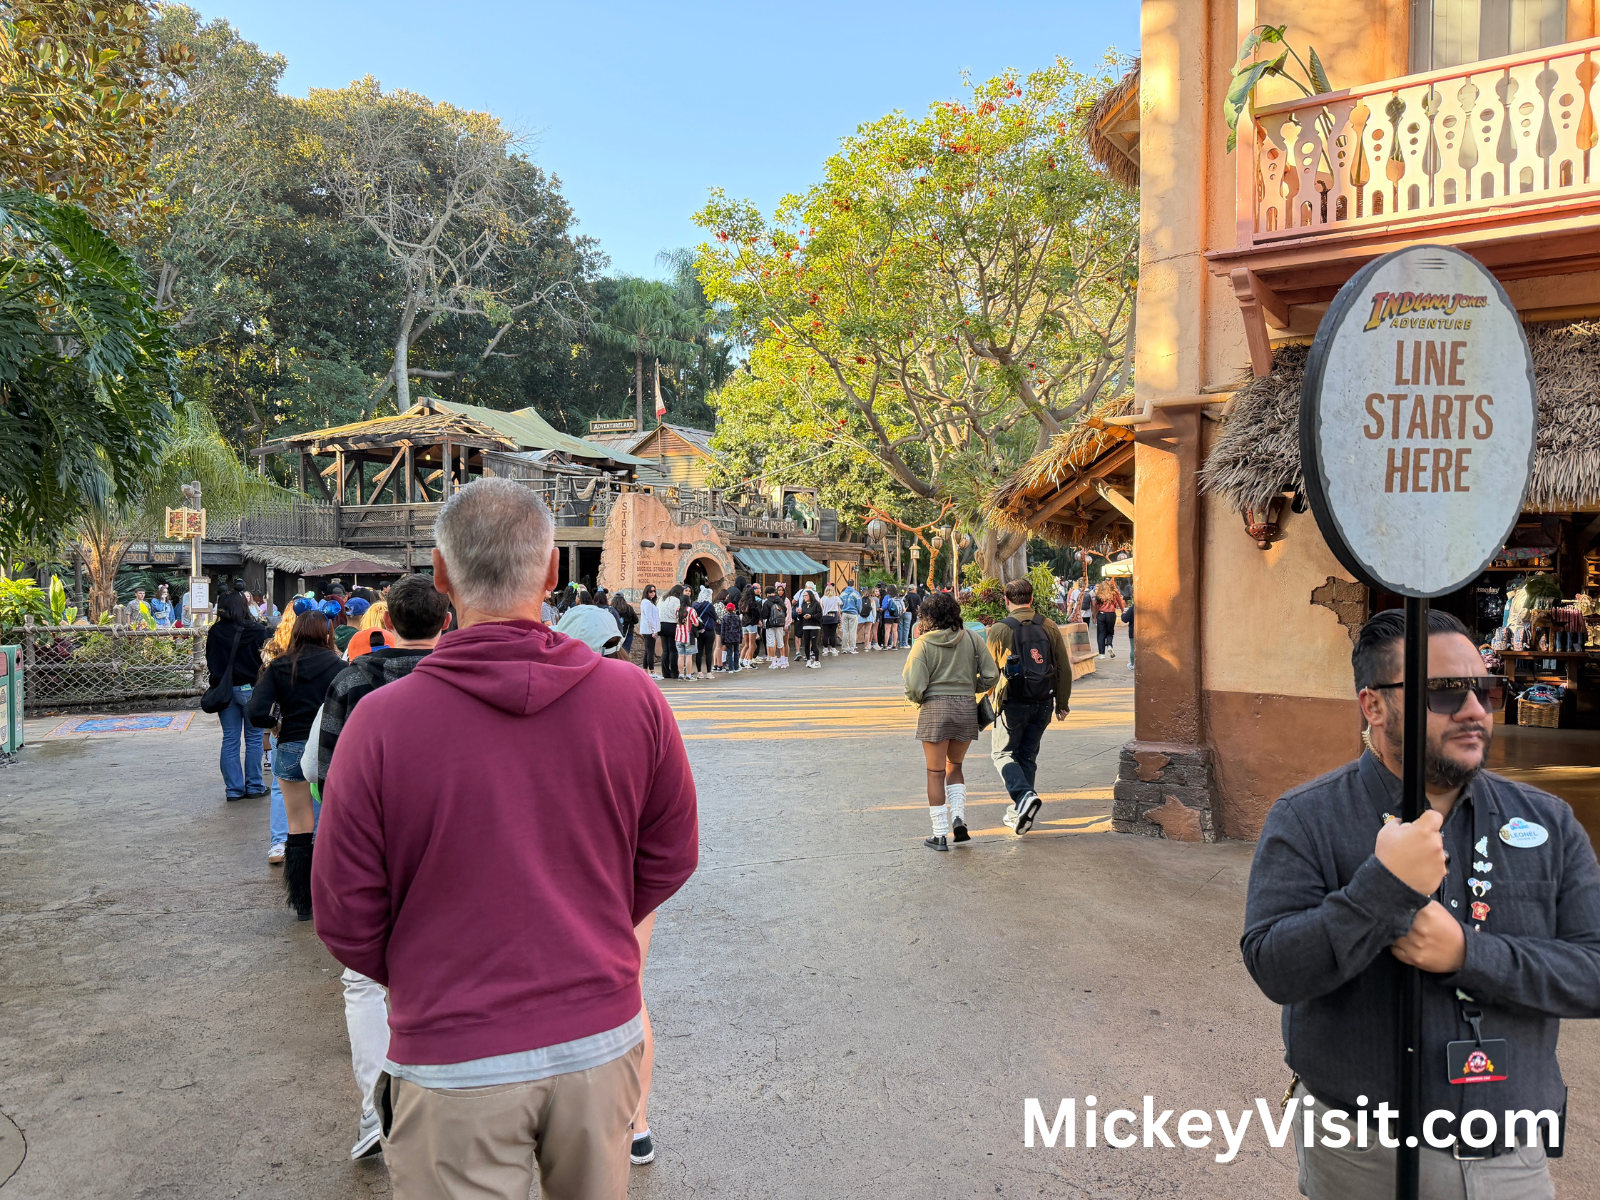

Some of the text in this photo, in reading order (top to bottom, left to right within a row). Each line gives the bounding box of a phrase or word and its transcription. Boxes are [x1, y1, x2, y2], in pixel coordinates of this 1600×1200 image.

[1363, 291, 1450, 332] INDIANA
[1390, 317, 1473, 331] ADVENTURE
[1395, 340, 1468, 386] LINE
[1363, 393, 1494, 440] STARTS
[1384, 447, 1472, 493] HERE
[621, 502, 629, 581] STROLLERS
[741, 517, 795, 532] TROPICAL IMPORTS
[126, 554, 176, 562] EXIT ONLY
